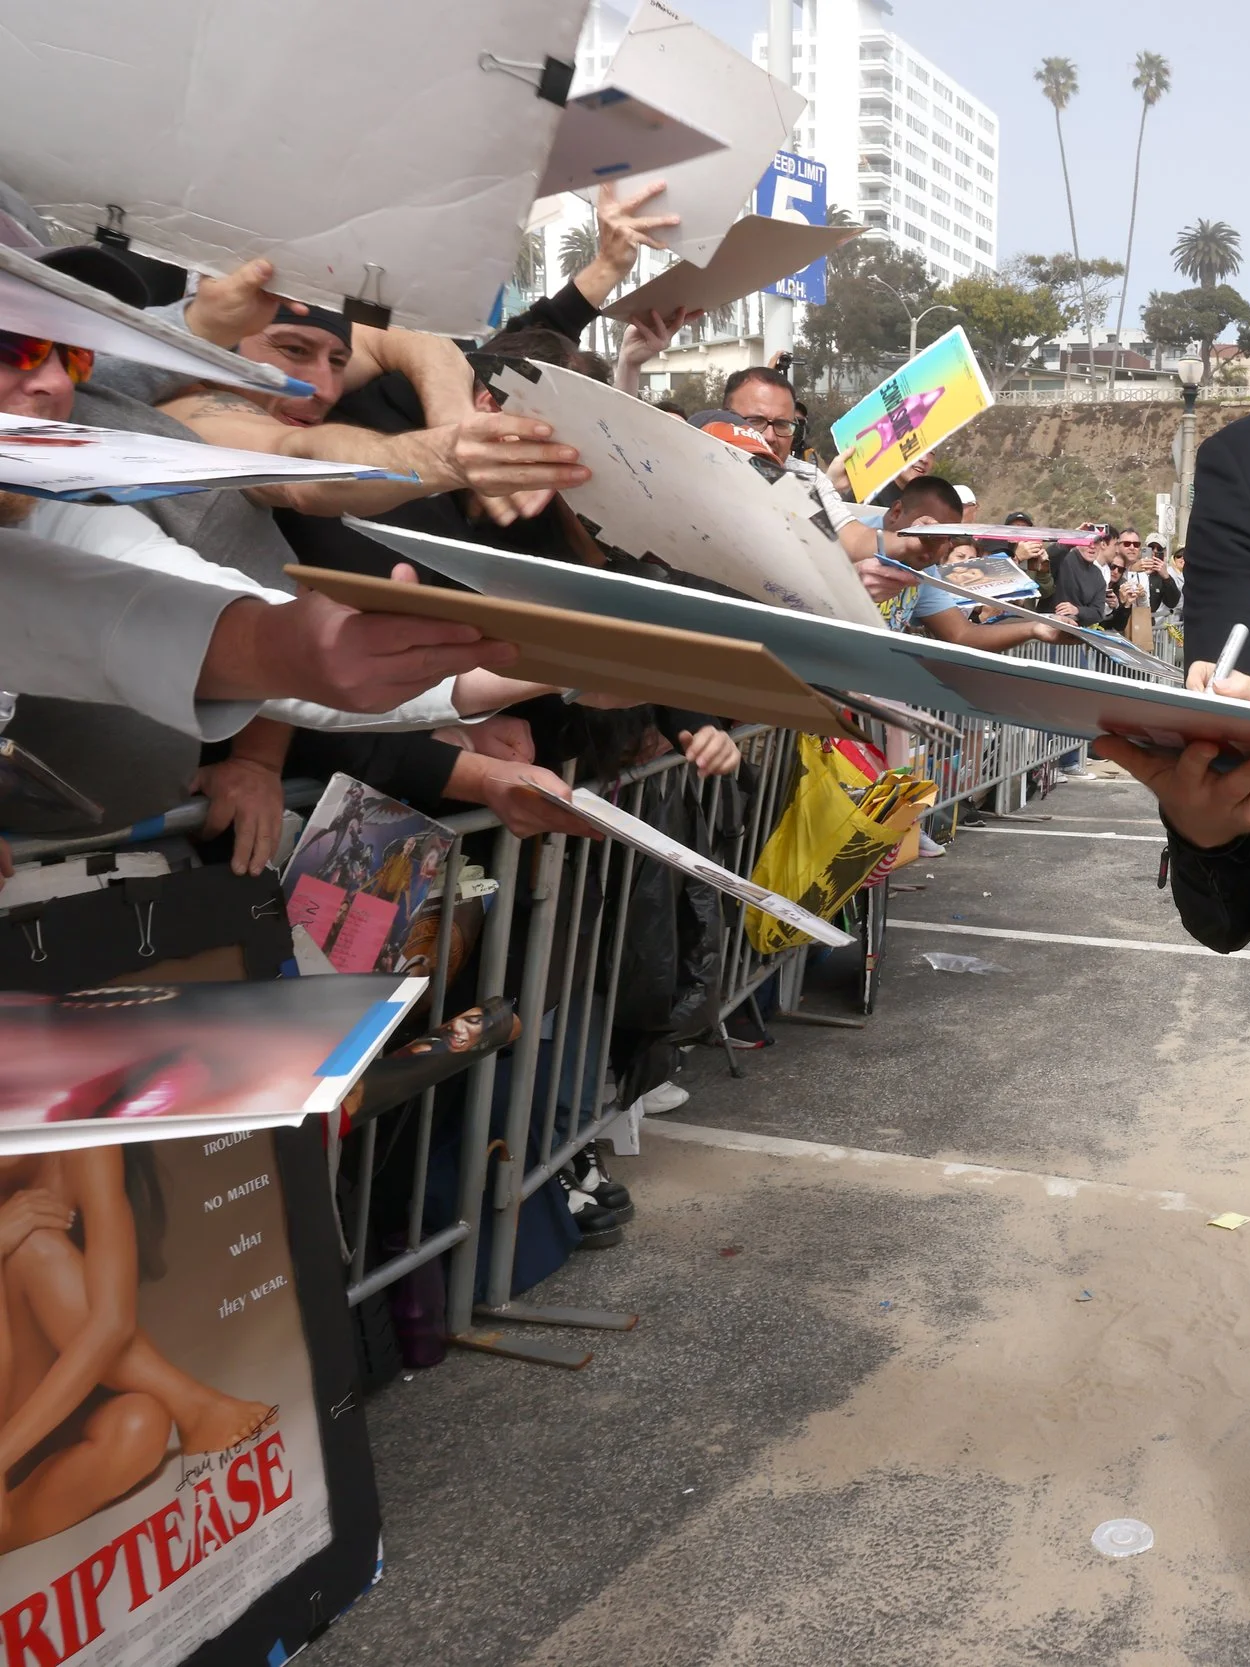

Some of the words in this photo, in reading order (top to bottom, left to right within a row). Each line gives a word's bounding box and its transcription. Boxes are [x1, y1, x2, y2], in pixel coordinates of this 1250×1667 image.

[774, 154, 796, 175] EED
[797, 160, 826, 184] LIMIT
[899, 432, 921, 462] THE
[204, 1195, 223, 1213] NO
[227, 1173, 270, 1202] MATTER
[229, 1231, 263, 1257] WHAT
[218, 1294, 247, 1319] THEY
[250, 1275, 288, 1301] WEAR.
[0, 1430, 293, 1667] RIPTEASE
